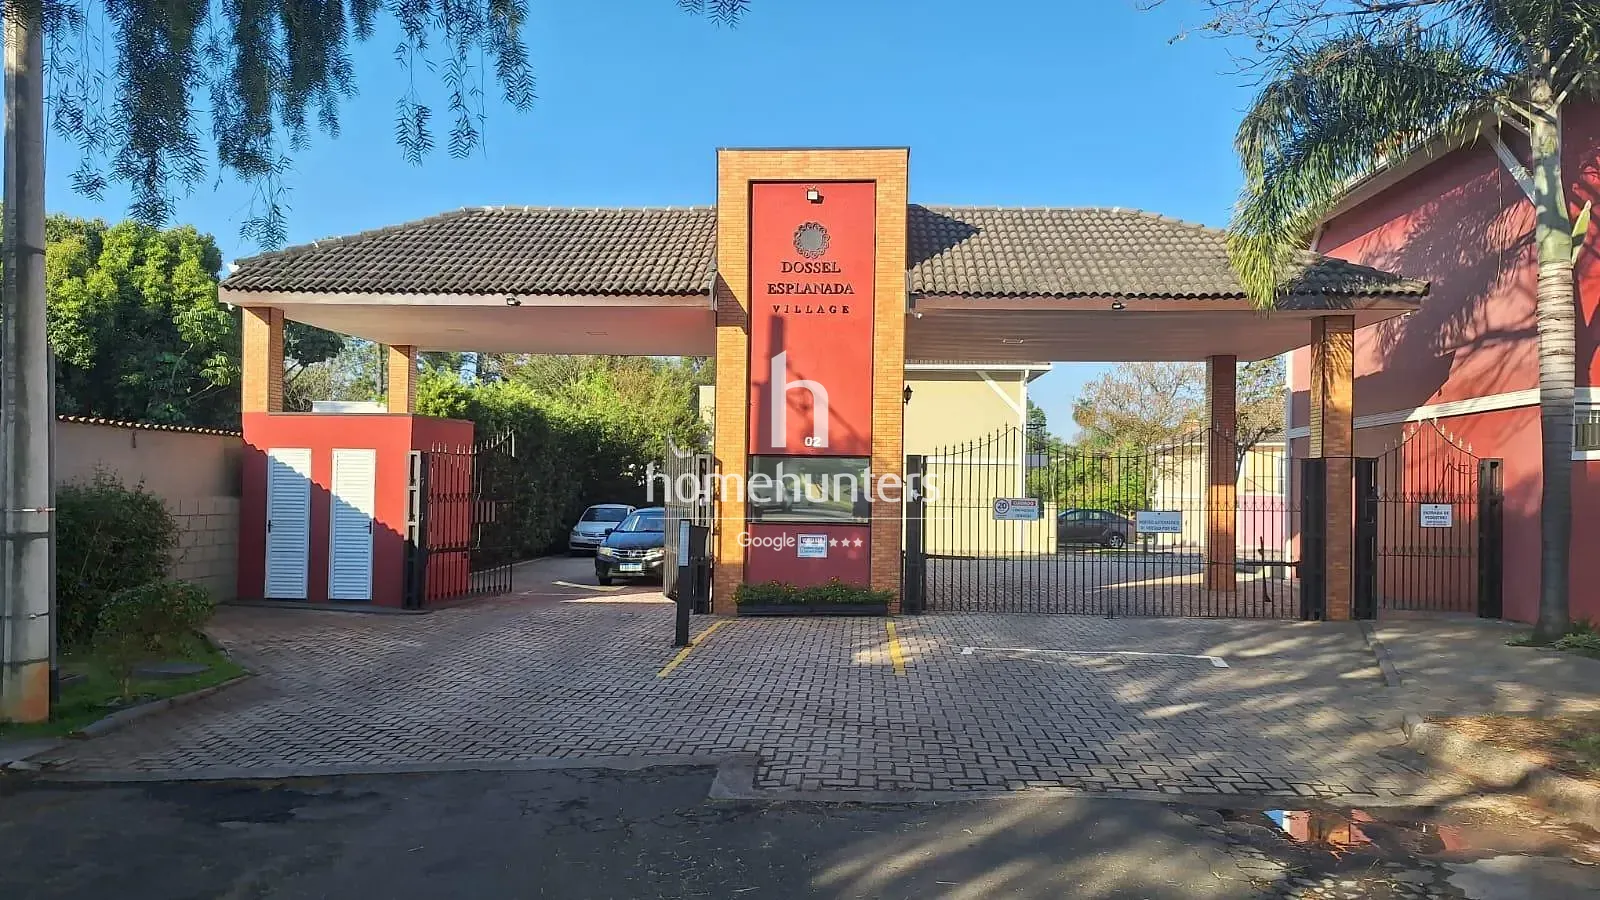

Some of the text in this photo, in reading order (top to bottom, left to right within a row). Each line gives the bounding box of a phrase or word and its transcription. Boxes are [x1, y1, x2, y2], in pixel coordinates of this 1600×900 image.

[781, 261, 841, 273] DOSSEL
[767, 283, 855, 295] ESPLANADA
[773, 304, 850, 314] VILLAGE
[804, 436, 822, 447] 02
